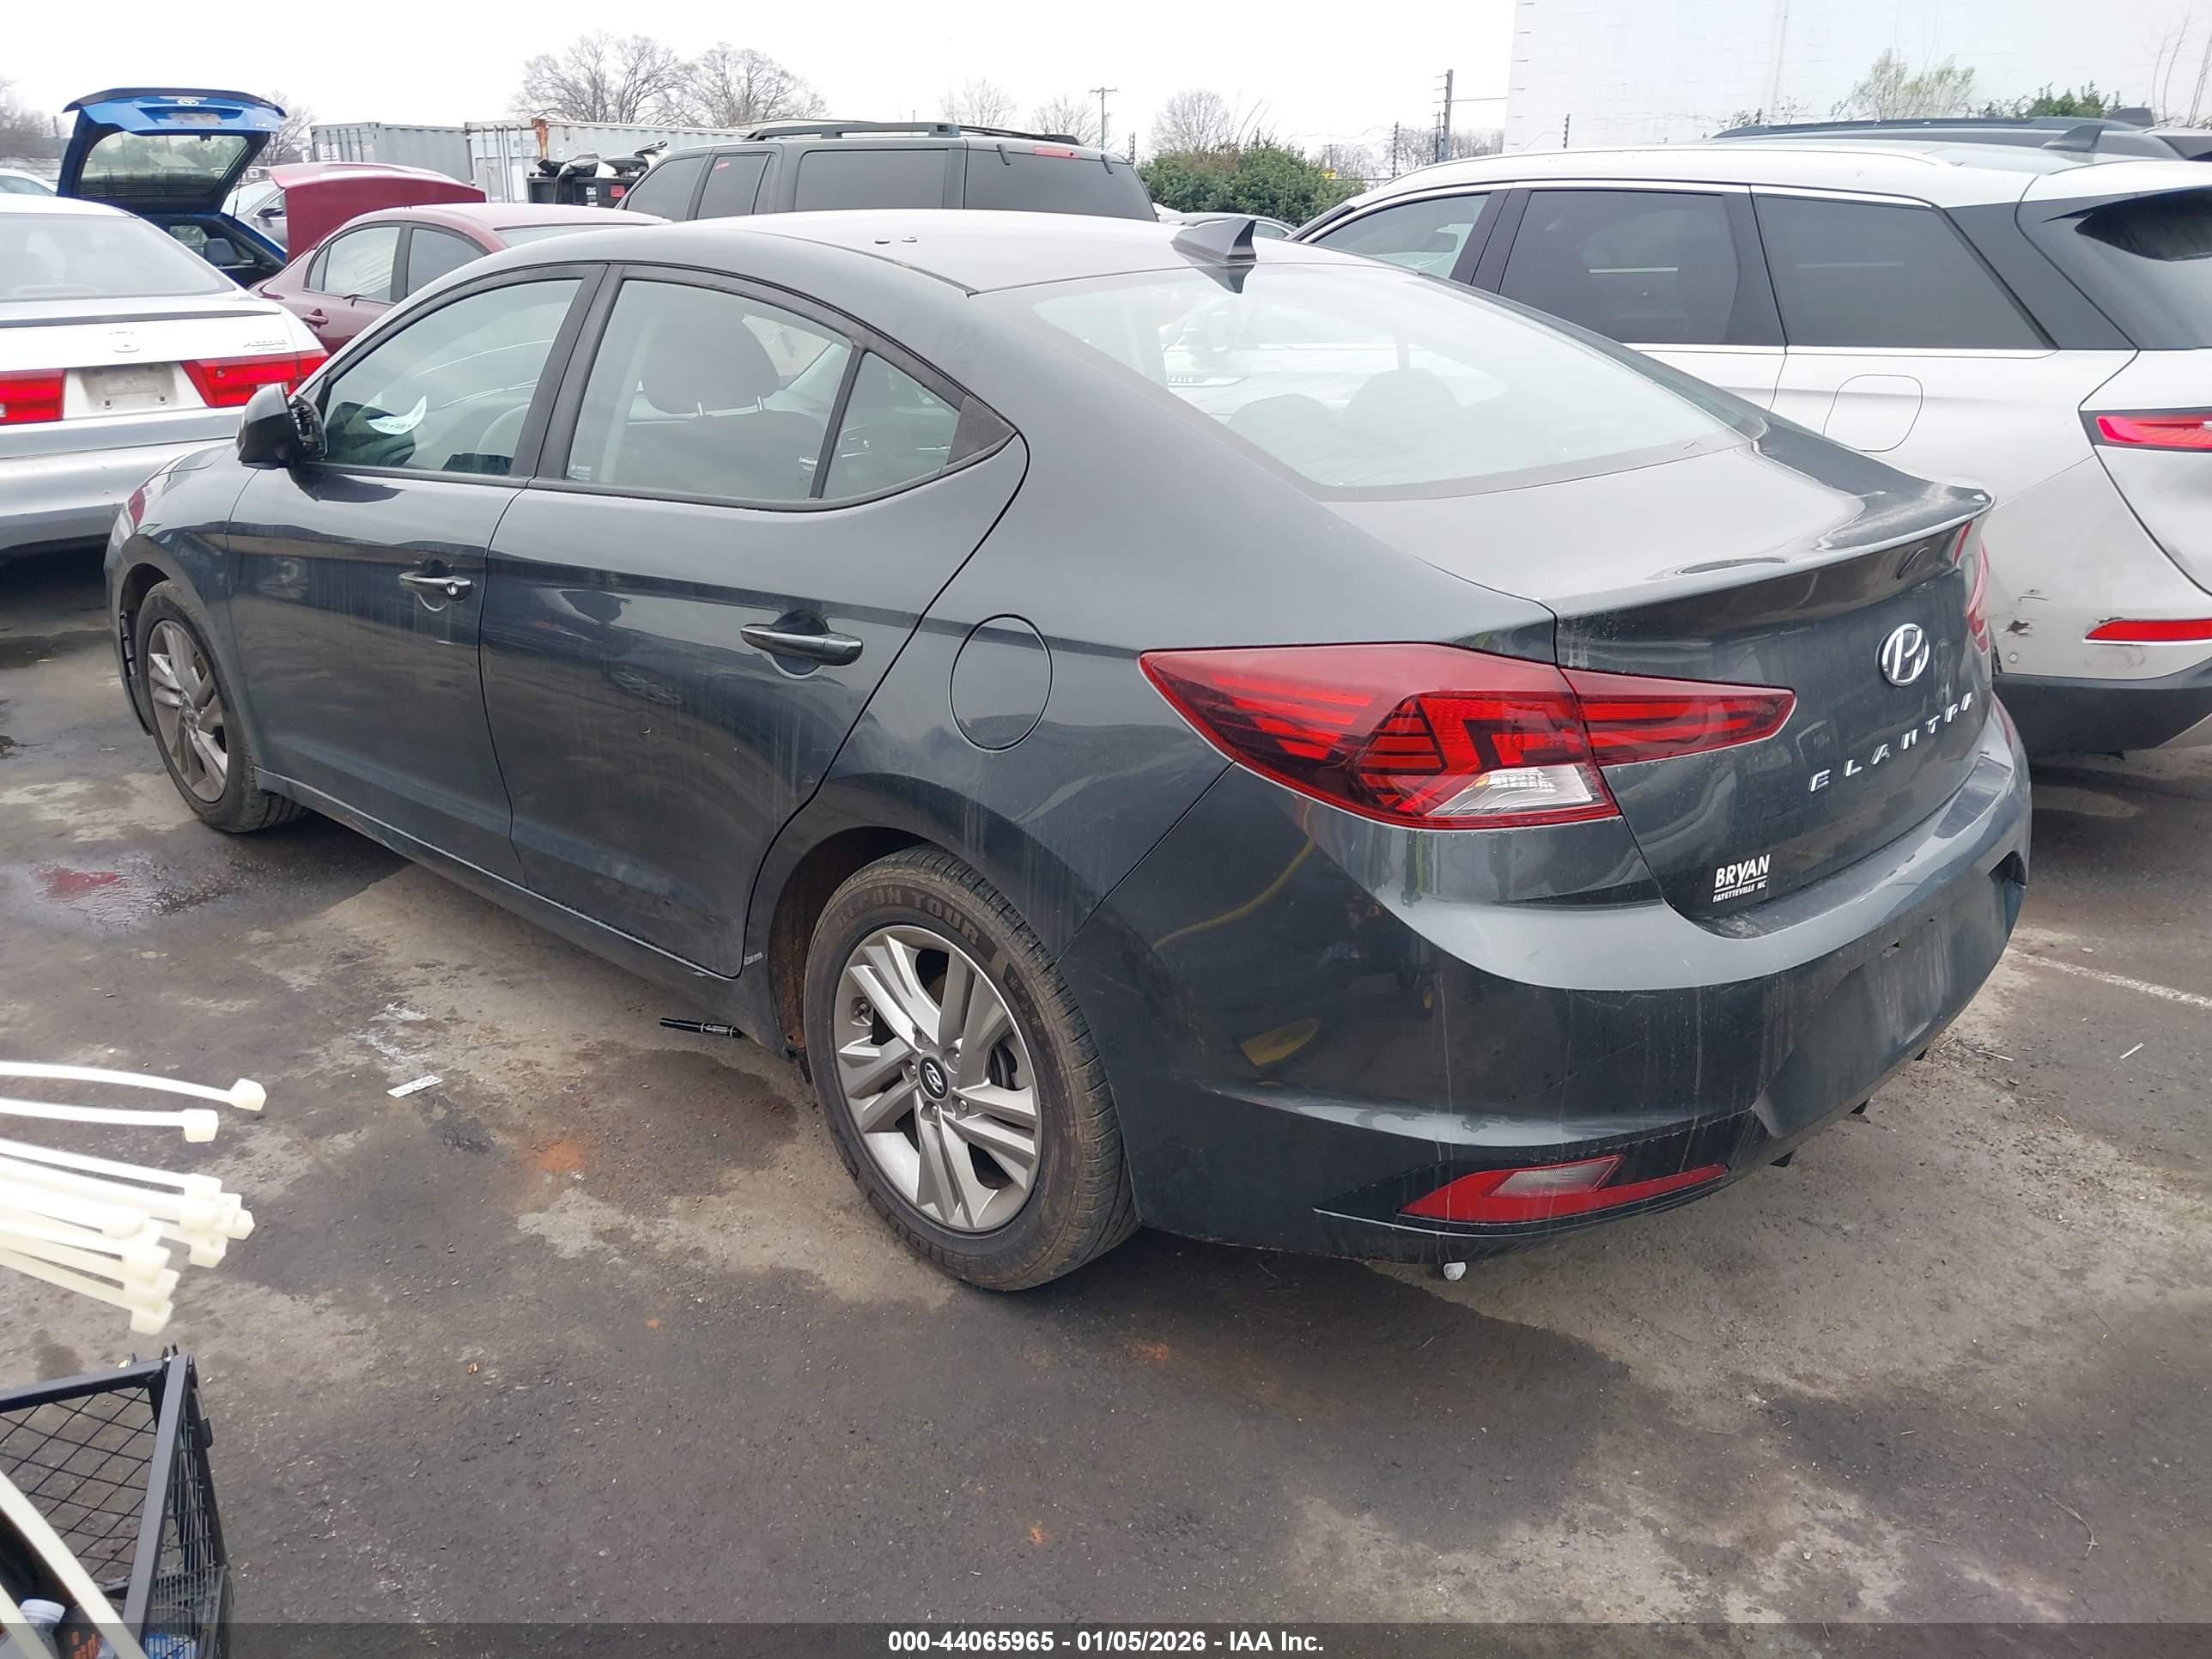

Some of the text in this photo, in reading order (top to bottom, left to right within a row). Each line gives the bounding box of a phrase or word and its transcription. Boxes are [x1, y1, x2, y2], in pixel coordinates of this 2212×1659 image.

[1808, 692, 1972, 792] ELANTRA
[1712, 880, 1767, 902] FAYETTEVILLE NC
[1715, 854, 1771, 888] BRYAN
[911, 891, 980, 945] TOUR
